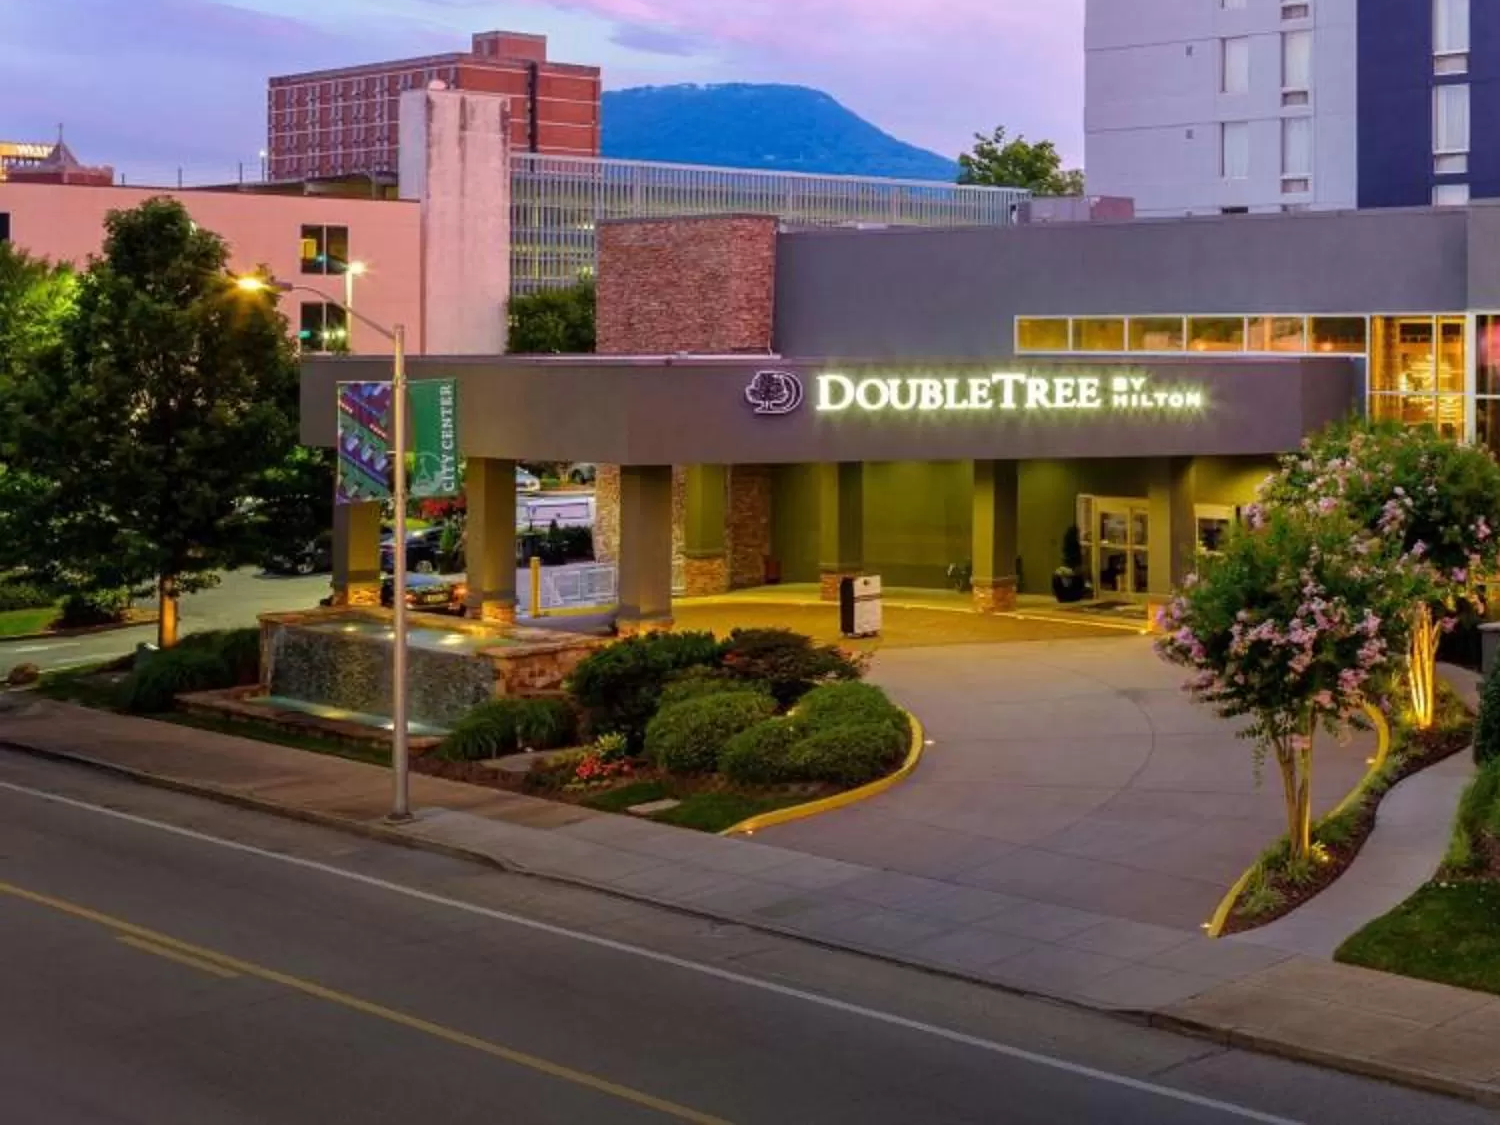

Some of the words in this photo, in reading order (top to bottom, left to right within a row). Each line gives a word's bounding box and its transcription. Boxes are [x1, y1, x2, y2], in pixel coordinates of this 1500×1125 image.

[1112, 376, 1146, 392] BY
[1112, 392, 1201, 408] HILTON
[440, 384, 453, 449] CENTER
[442, 454, 454, 491] CITY
